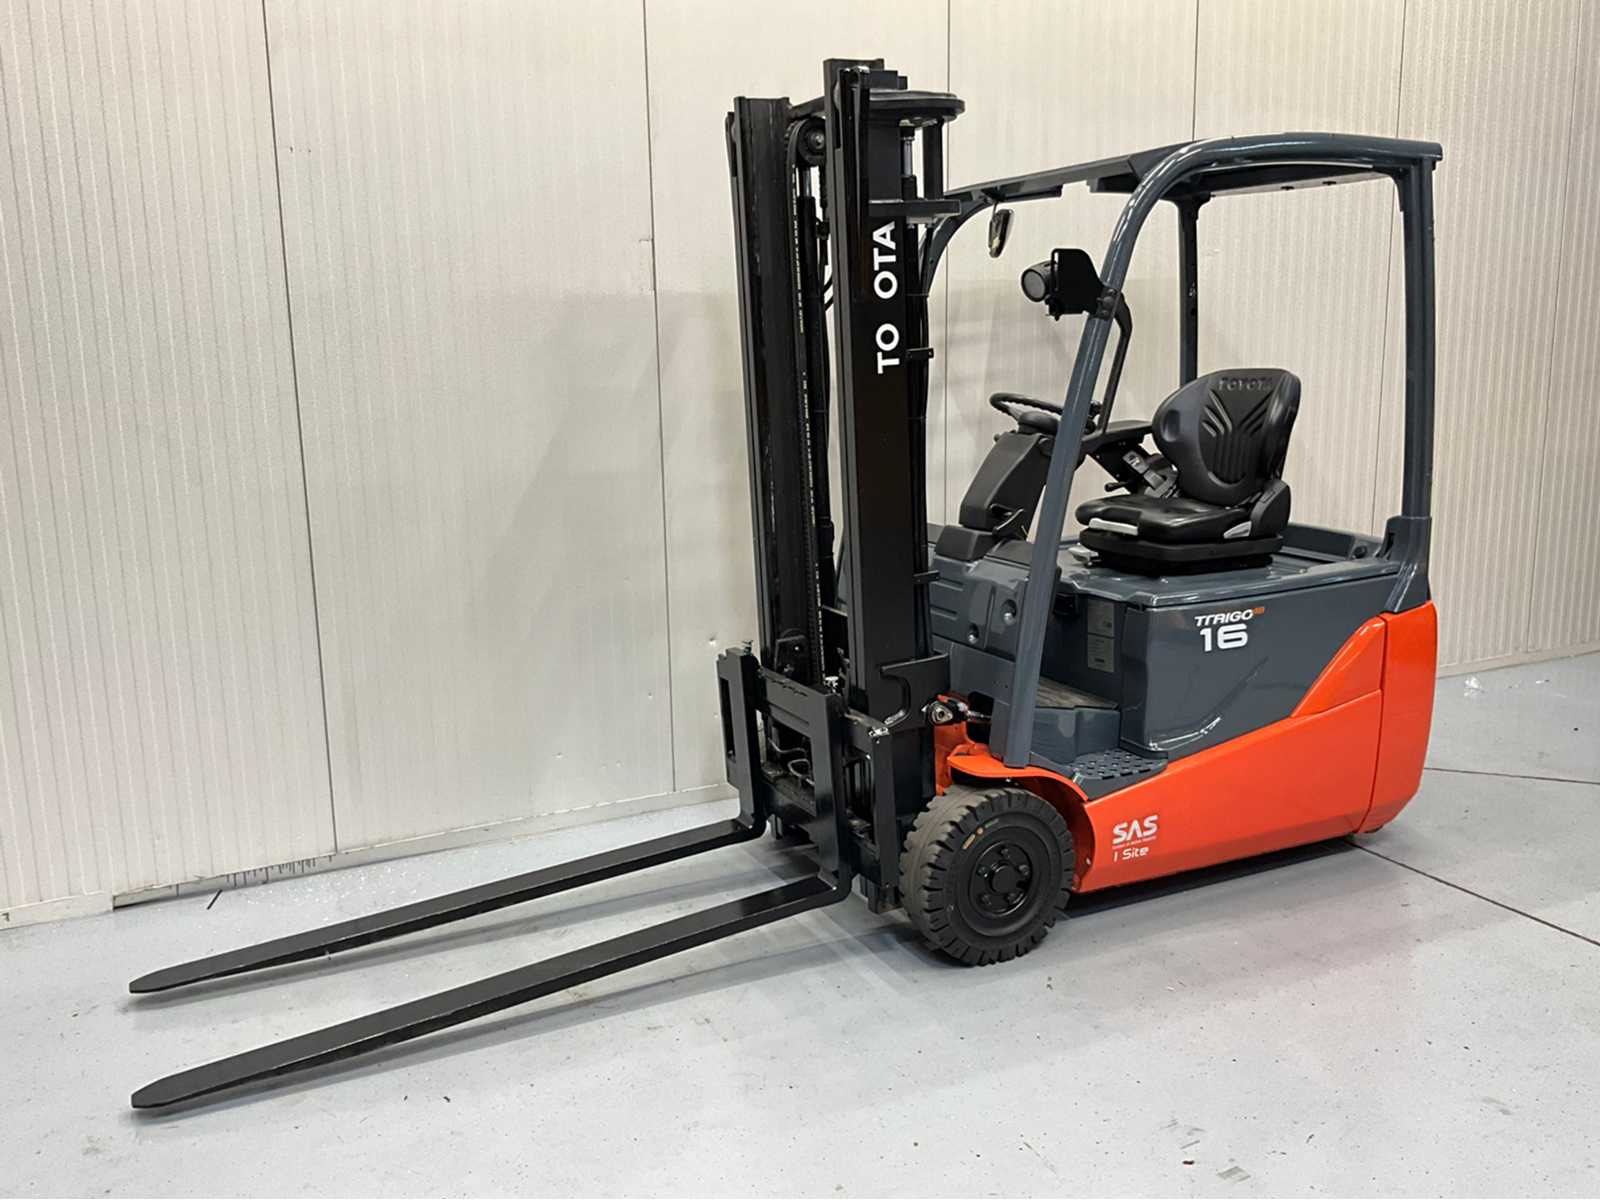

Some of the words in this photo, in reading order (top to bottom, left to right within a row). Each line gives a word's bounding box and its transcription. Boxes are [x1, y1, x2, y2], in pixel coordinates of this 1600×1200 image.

[1199, 623, 1248, 652] 16
[1112, 814, 1158, 845] SAS
[1122, 847, 1149, 860] Site
